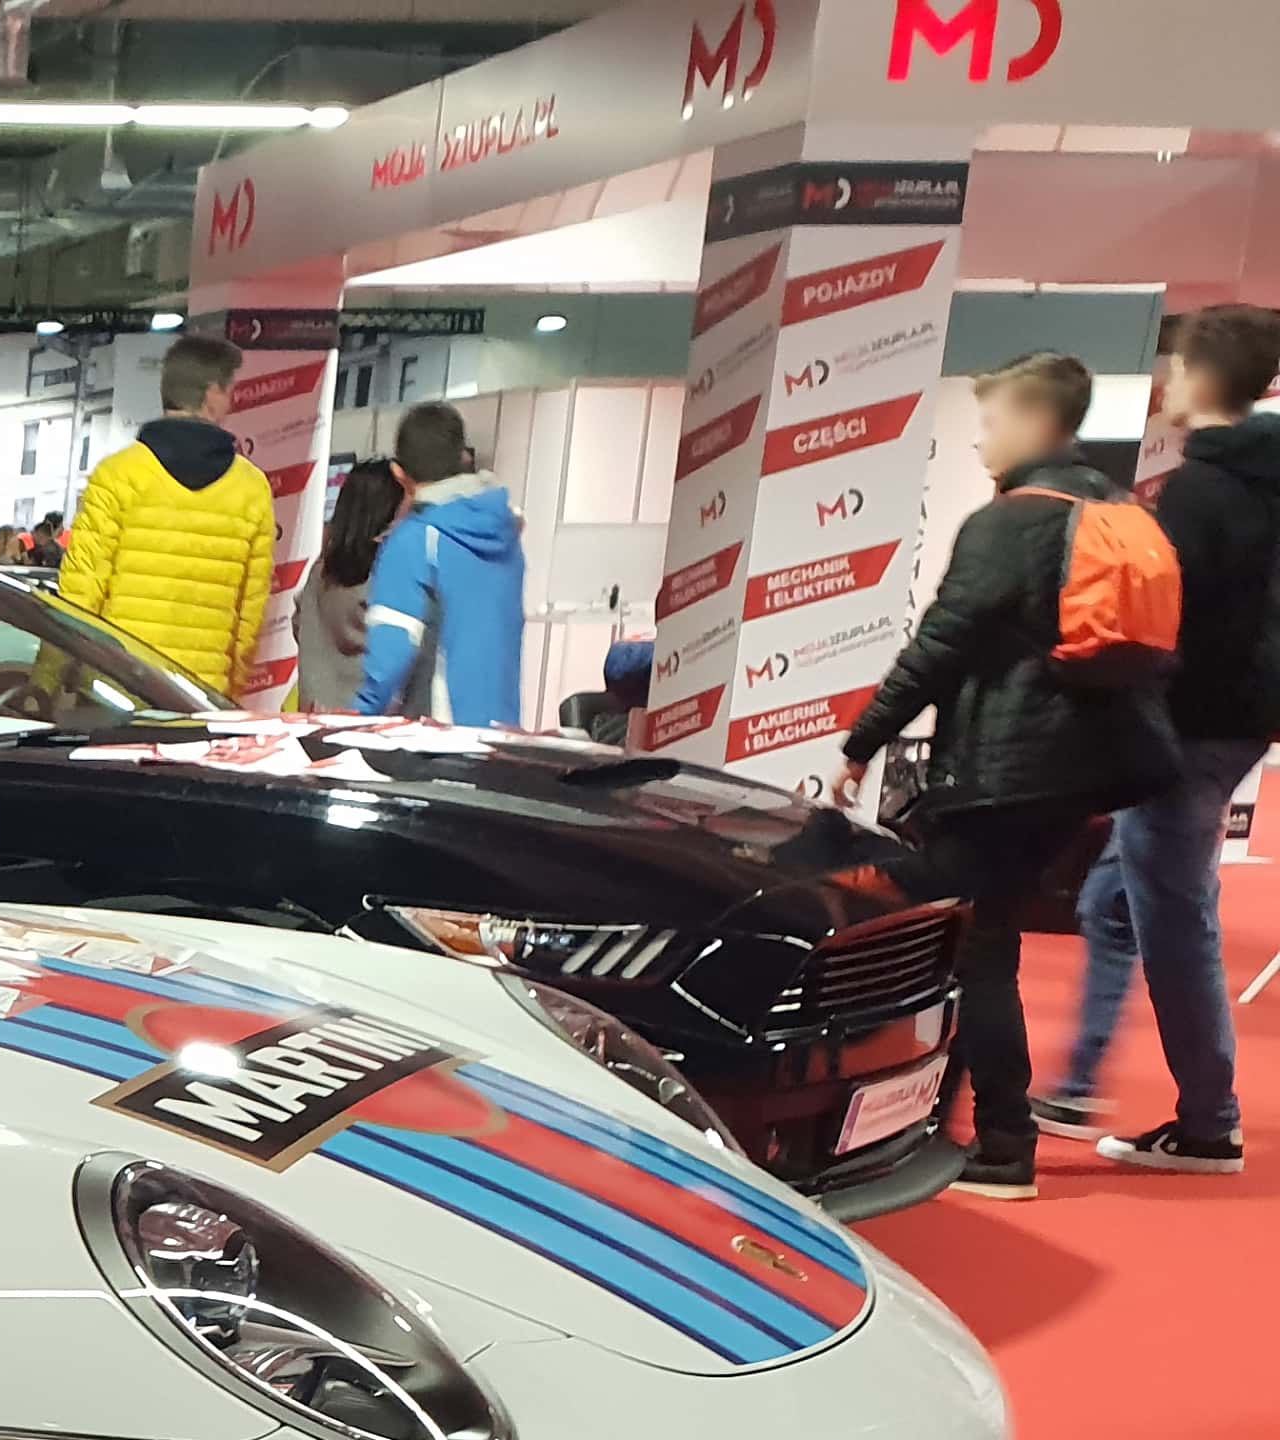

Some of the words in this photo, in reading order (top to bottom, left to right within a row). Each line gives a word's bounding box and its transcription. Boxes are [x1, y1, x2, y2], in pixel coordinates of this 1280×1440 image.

[803, 263, 897, 307] POJAZDY
[767, 556, 851, 591] MECHANIK
[774, 572, 856, 608] ELEKTRYK
[748, 699, 831, 735] LAKIERNIK
[752, 714, 837, 750] BLACHARZ
[153, 1014, 441, 1143] MARTINI
